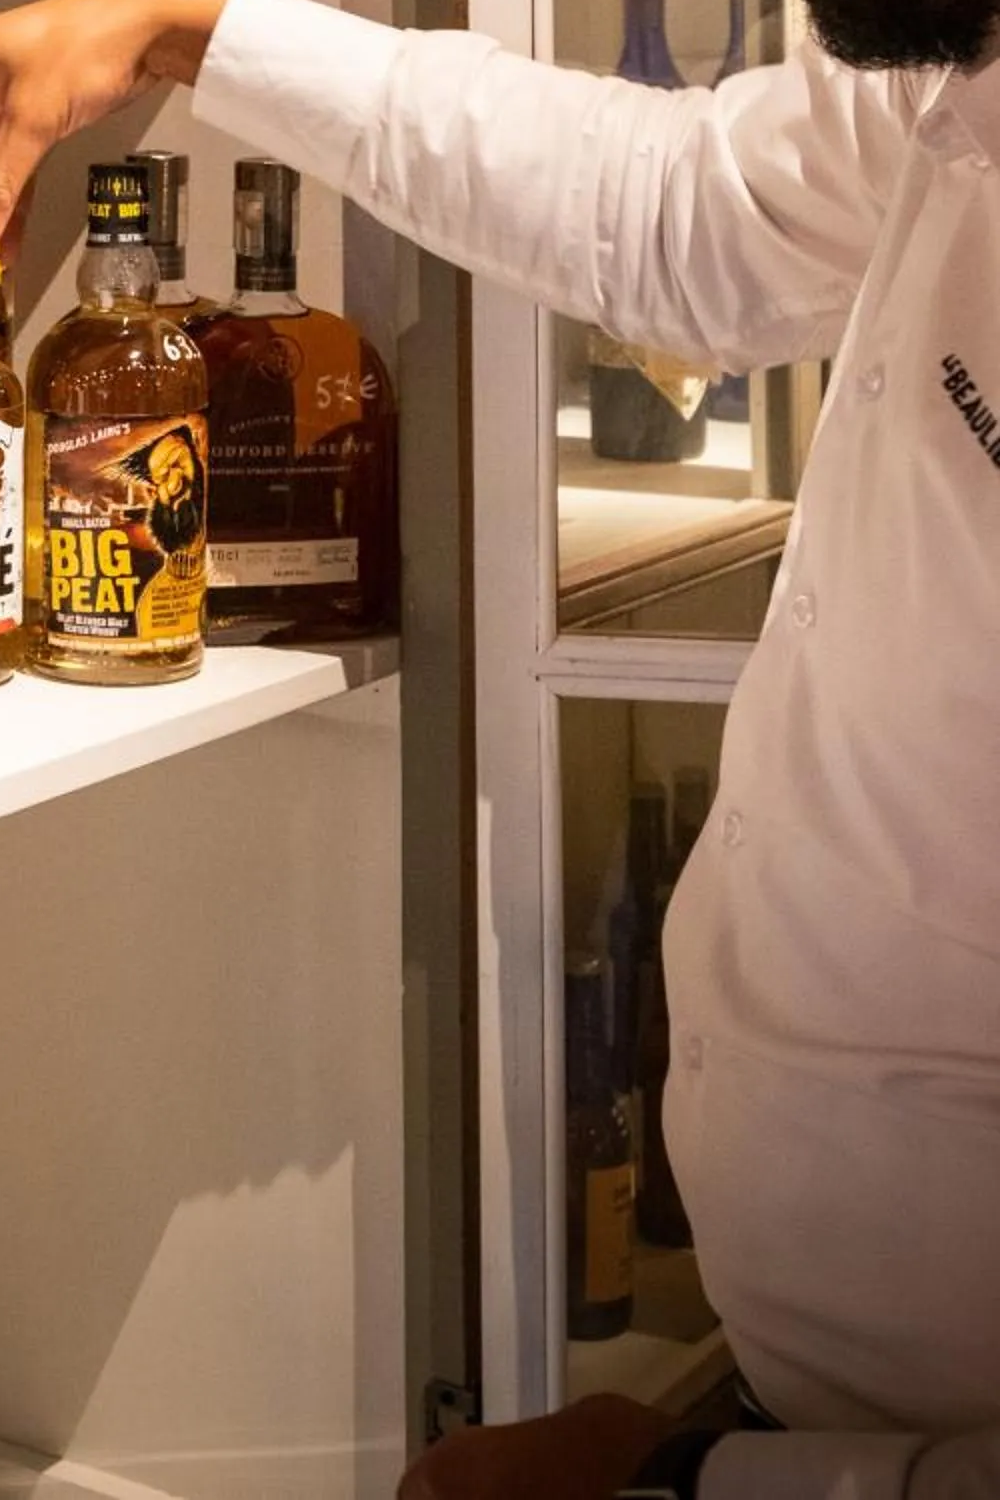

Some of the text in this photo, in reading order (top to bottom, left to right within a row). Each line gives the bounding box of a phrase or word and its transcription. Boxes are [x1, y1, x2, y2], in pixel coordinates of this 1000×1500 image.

[211, 443, 287, 458] ODFORD
[50, 529, 133, 578] BIG
[51, 575, 141, 614] PEAT
